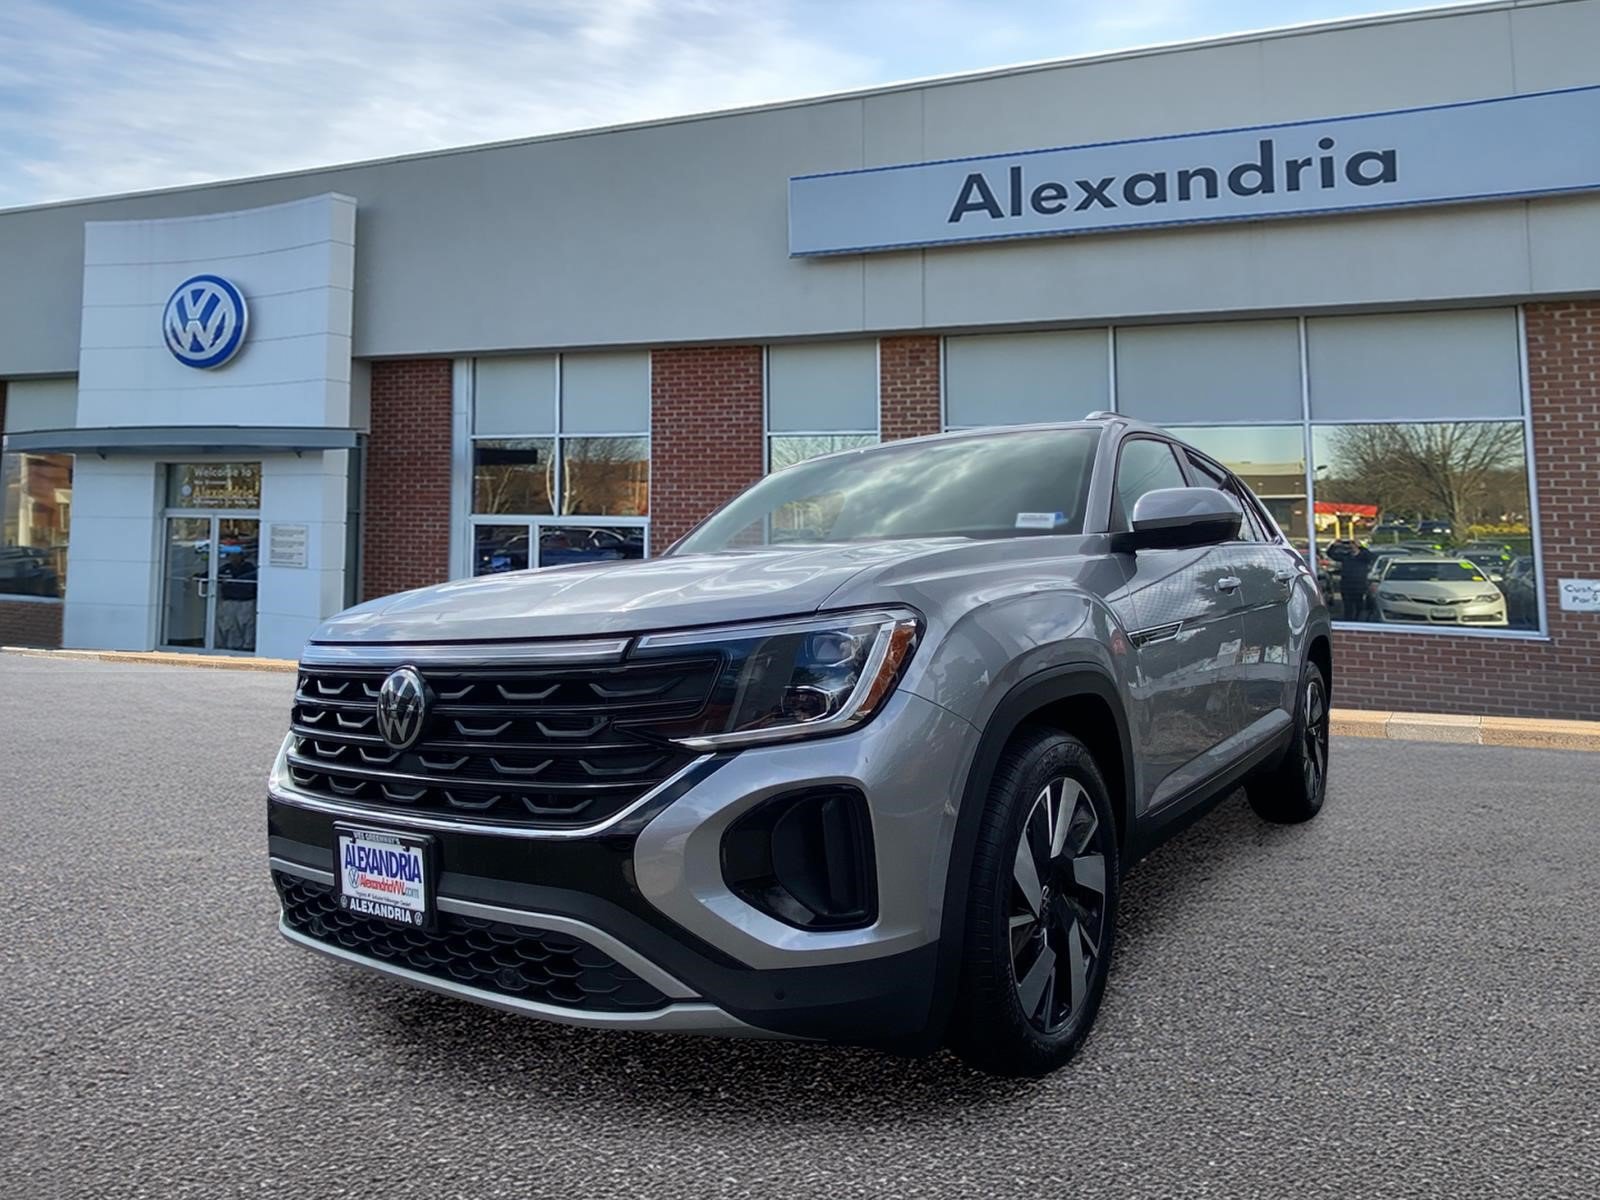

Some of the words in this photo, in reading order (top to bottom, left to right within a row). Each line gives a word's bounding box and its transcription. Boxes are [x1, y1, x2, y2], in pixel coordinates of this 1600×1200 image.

[948, 137, 1398, 223] Alexandria
[345, 844, 422, 883] ALEXANDRIA
[349, 898, 412, 923] ALEXANDRIA
